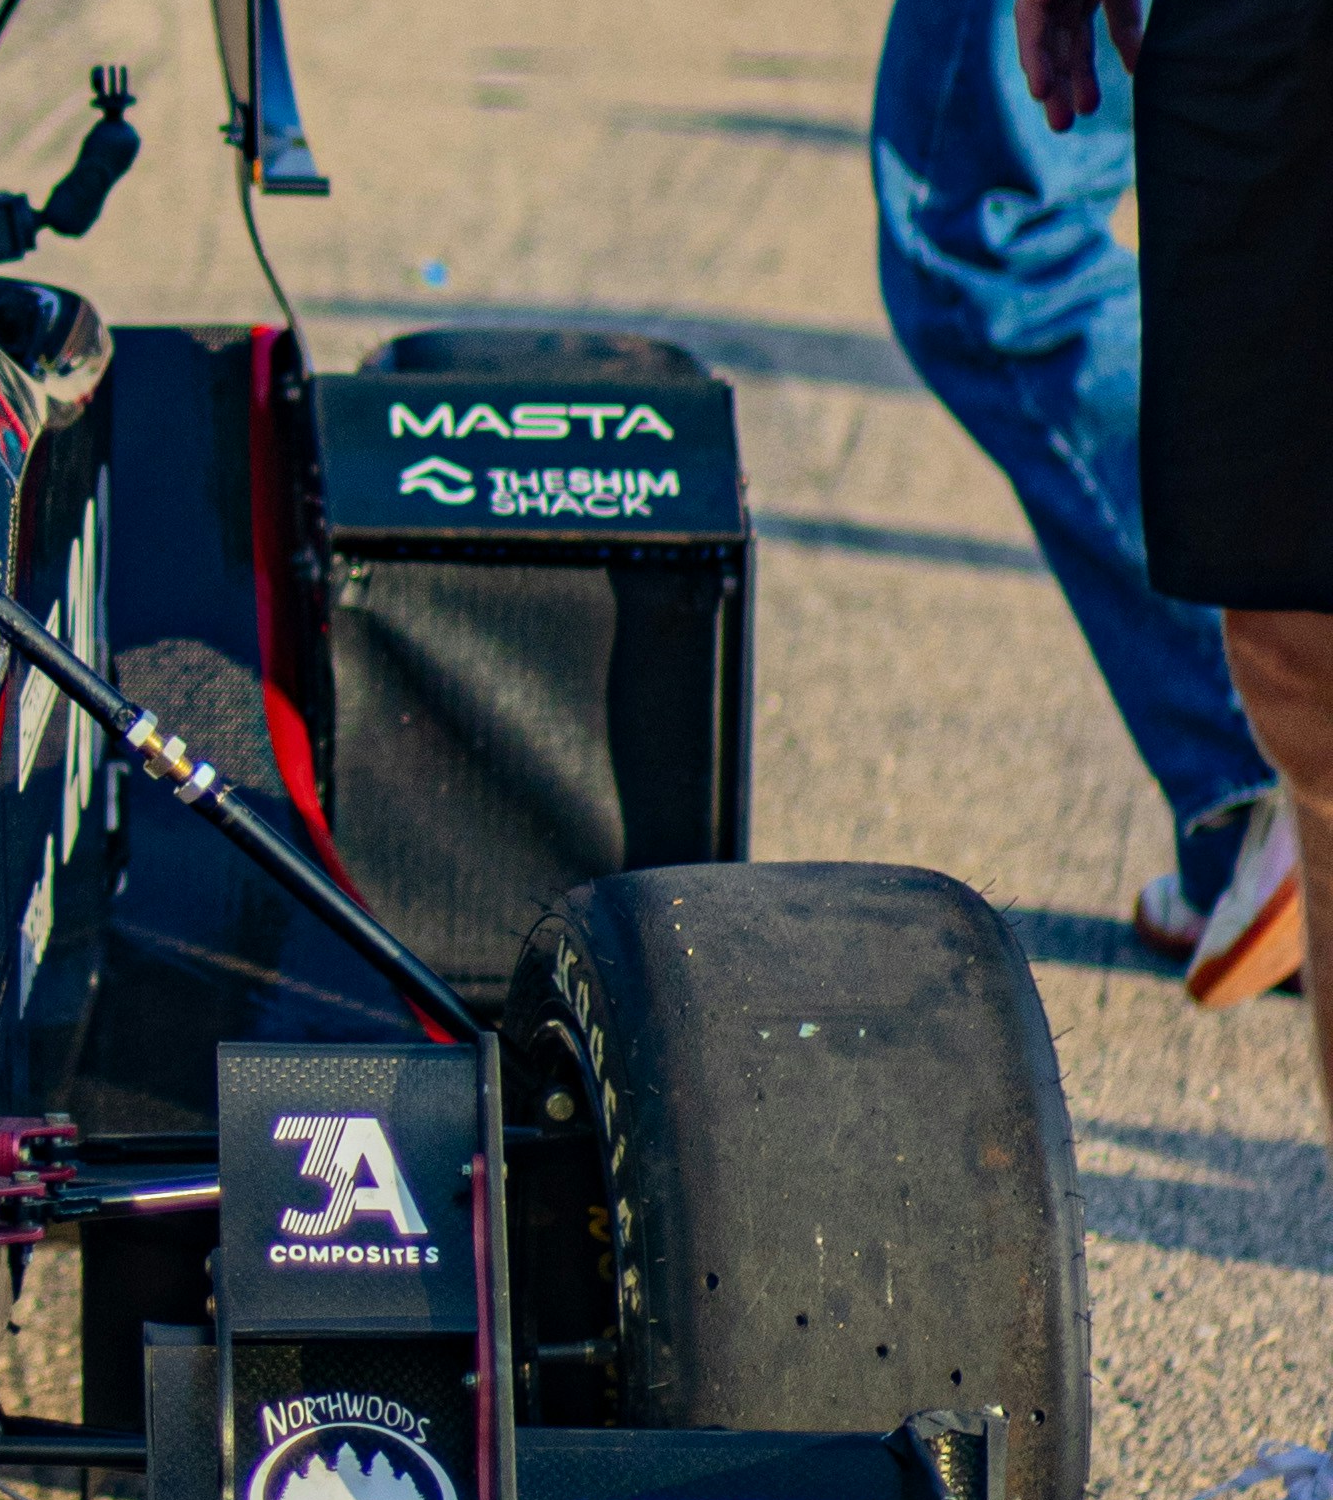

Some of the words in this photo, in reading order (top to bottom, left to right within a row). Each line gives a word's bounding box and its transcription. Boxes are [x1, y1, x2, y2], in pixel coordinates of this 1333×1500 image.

[389, 402, 675, 440] MASTA
[491, 496, 652, 517] SHACK
[273, 1116, 429, 1236] 3A
[269, 1244, 440, 1265] COMPOSITES
